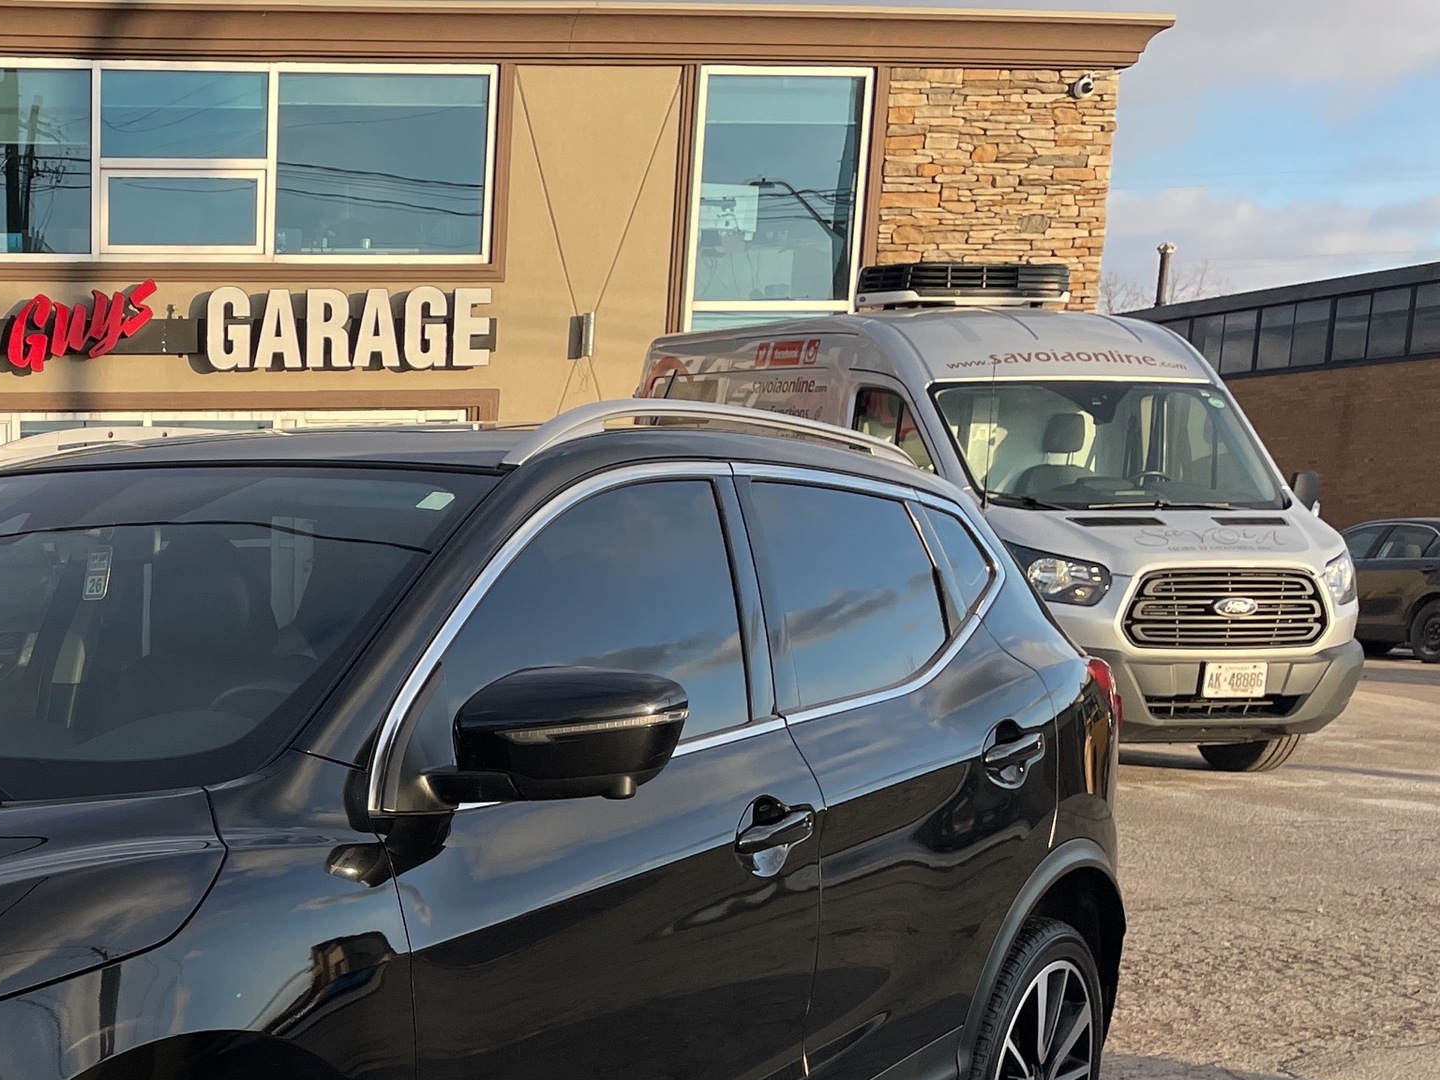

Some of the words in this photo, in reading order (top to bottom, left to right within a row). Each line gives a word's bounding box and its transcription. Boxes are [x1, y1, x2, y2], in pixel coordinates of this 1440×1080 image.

[7, 278, 158, 373] Guys
[206, 285, 492, 370] GARAGE
[946, 348, 1187, 371] www.savoiaonline.com
[87, 577, 103, 594] 26
[1223, 600, 1253, 613] Ford
[1207, 672, 1223, 689] AK
[1227, 671, 1264, 688] 48886
